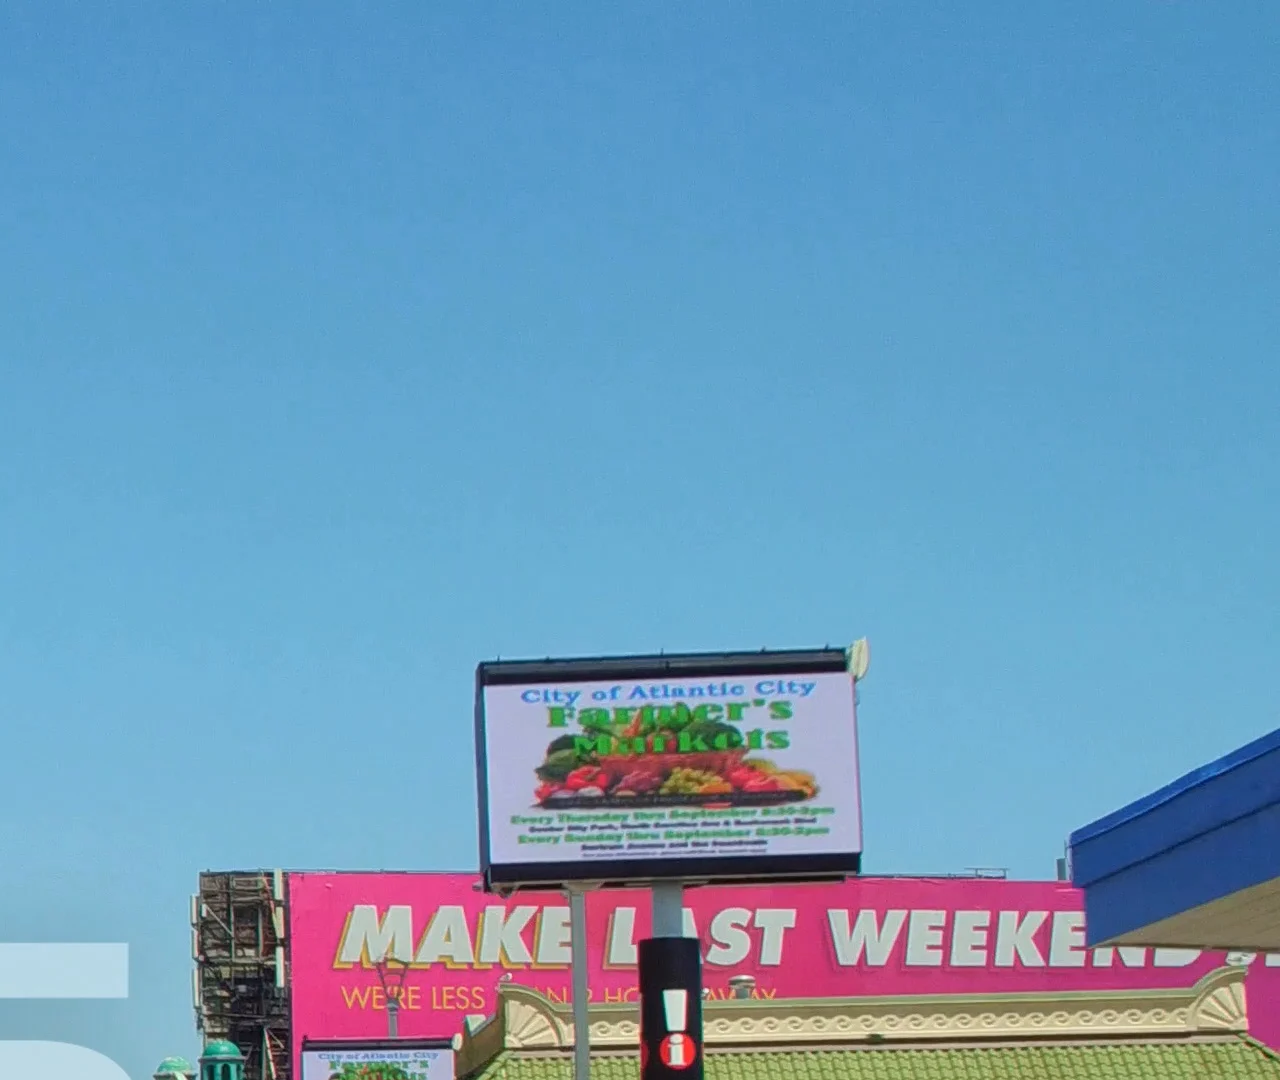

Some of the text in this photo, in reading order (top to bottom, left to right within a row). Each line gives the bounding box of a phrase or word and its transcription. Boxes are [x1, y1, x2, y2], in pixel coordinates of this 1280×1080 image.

[520, 679, 817, 707] City of Atlantic City
[546, 698, 794, 728] Farmer's
[572, 728, 791, 756] Markets
[669, 808, 757, 820] September
[663, 829, 750, 841] September
[333, 905, 571, 969] MAKE
[604, 906, 797, 968] LST
[340, 985, 485, 1010] WE'RE LESS
[318, 1053, 344, 1062] City
[361, 1052, 410, 1060] Atlantic
[413, 1052, 439, 1060] City
